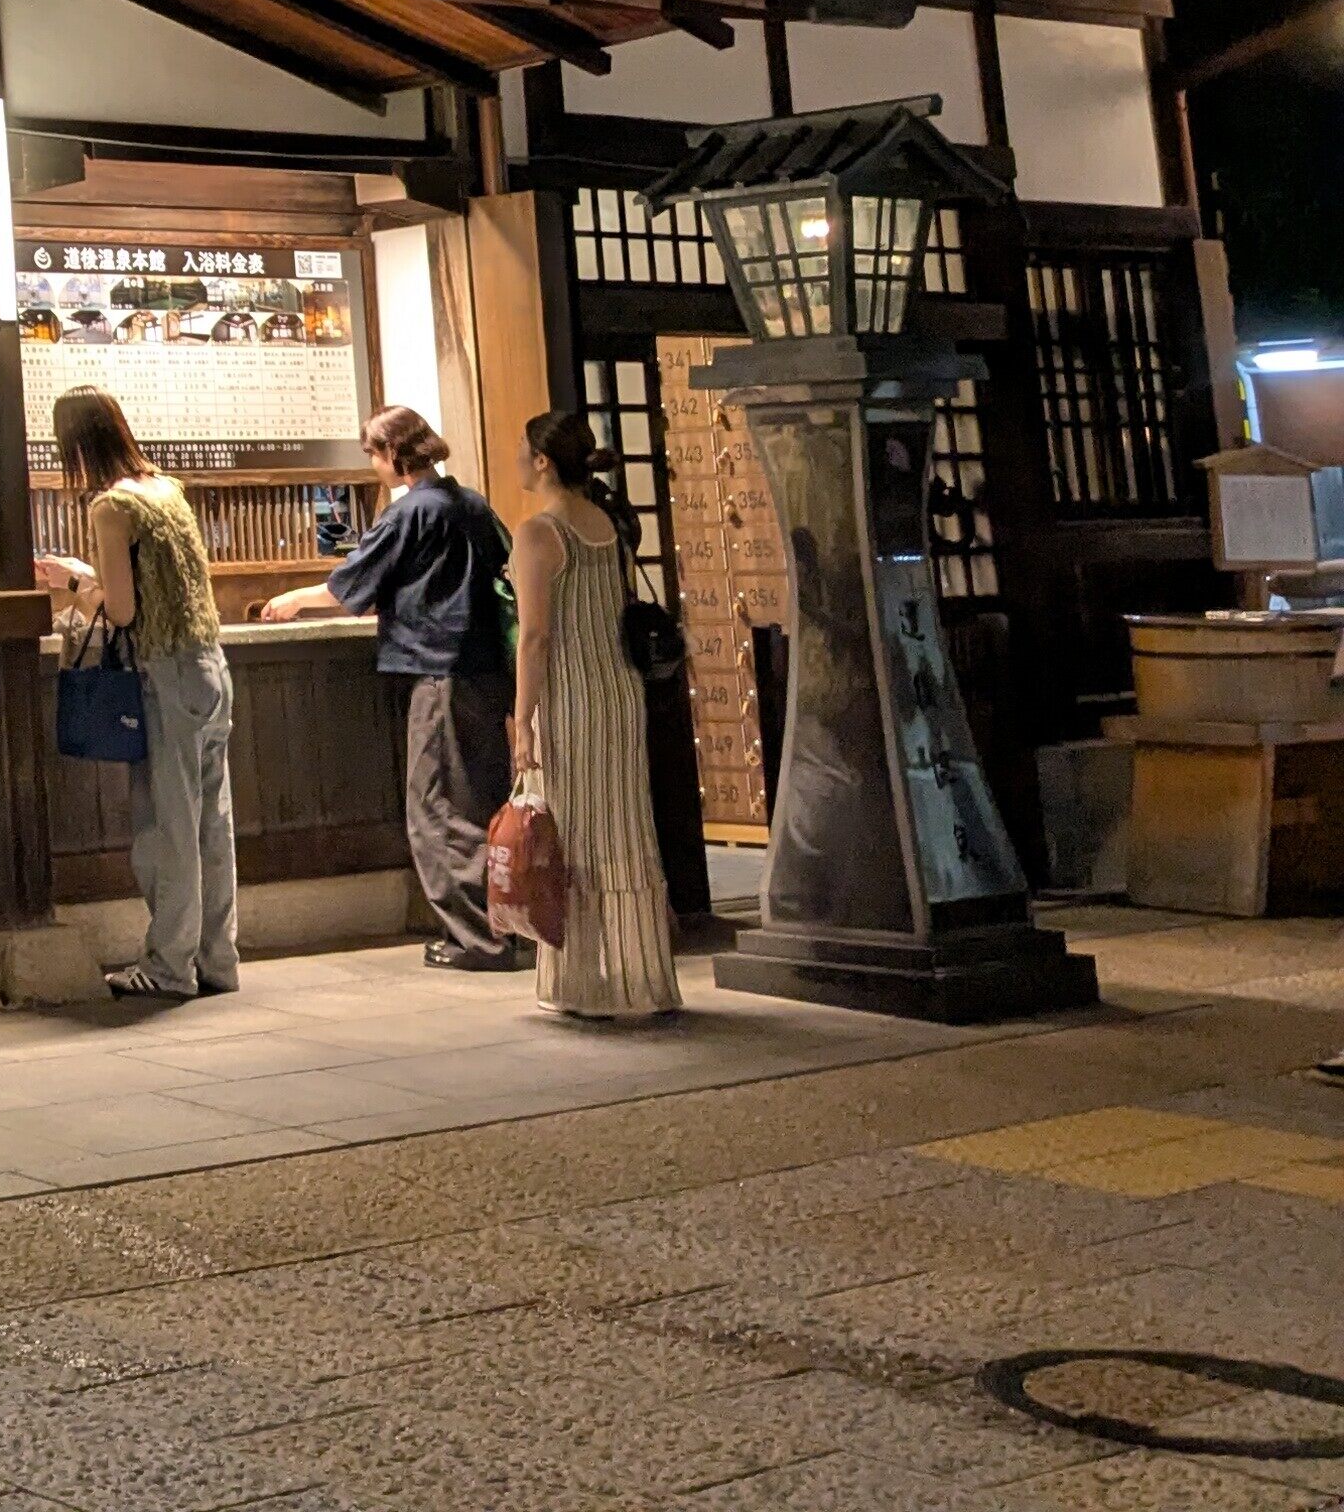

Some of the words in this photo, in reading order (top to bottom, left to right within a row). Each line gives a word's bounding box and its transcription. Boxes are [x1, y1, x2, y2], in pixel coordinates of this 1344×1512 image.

[64, 246, 166, 272] 道後温泉本館
[183, 250, 265, 275] 入浴料金表
[665, 349, 692, 369] 341
[670, 397, 699, 416] 342
[674, 445, 704, 464] 343
[734, 442, 759, 460] 35
[679, 492, 708, 511] 344
[739, 490, 767, 509] 354
[685, 540, 714, 559] 345
[690, 589, 718, 607] 346
[749, 588, 778, 607] 356
[695, 637, 723, 657] 347
[701, 687, 729, 705] 348
[705, 735, 734, 753] 349
[711, 784, 739, 802] 350
